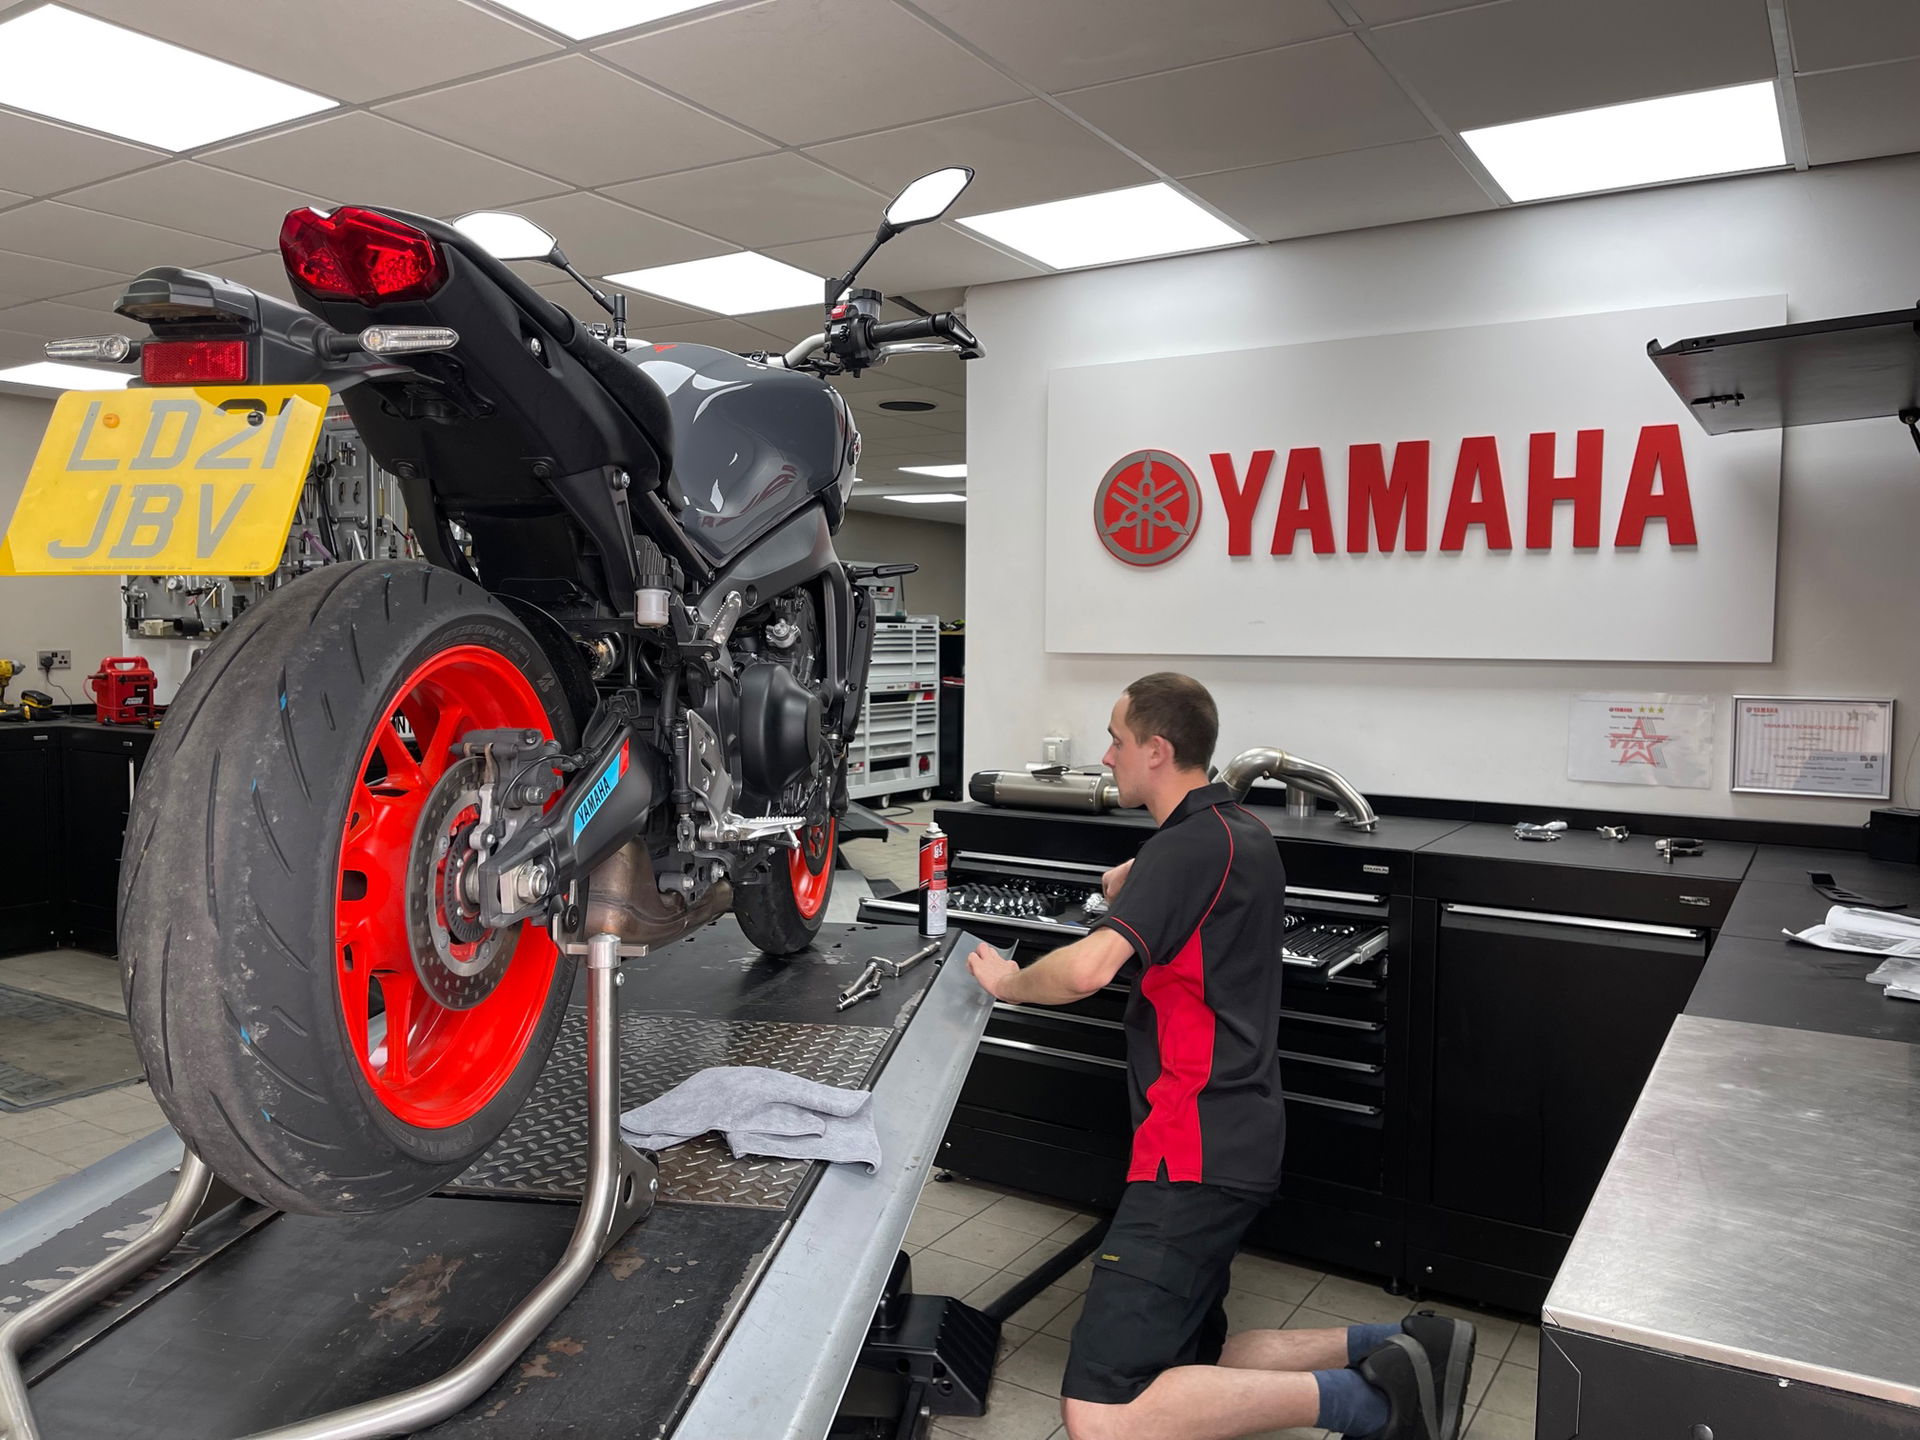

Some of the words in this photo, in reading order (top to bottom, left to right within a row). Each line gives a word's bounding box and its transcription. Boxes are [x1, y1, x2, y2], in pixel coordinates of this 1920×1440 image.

[66, 398, 296, 471] LD21
[47, 483, 256, 559] JBV
[1209, 424, 1697, 557] YAMAHA
[578, 776, 611, 825] YAMAHA
